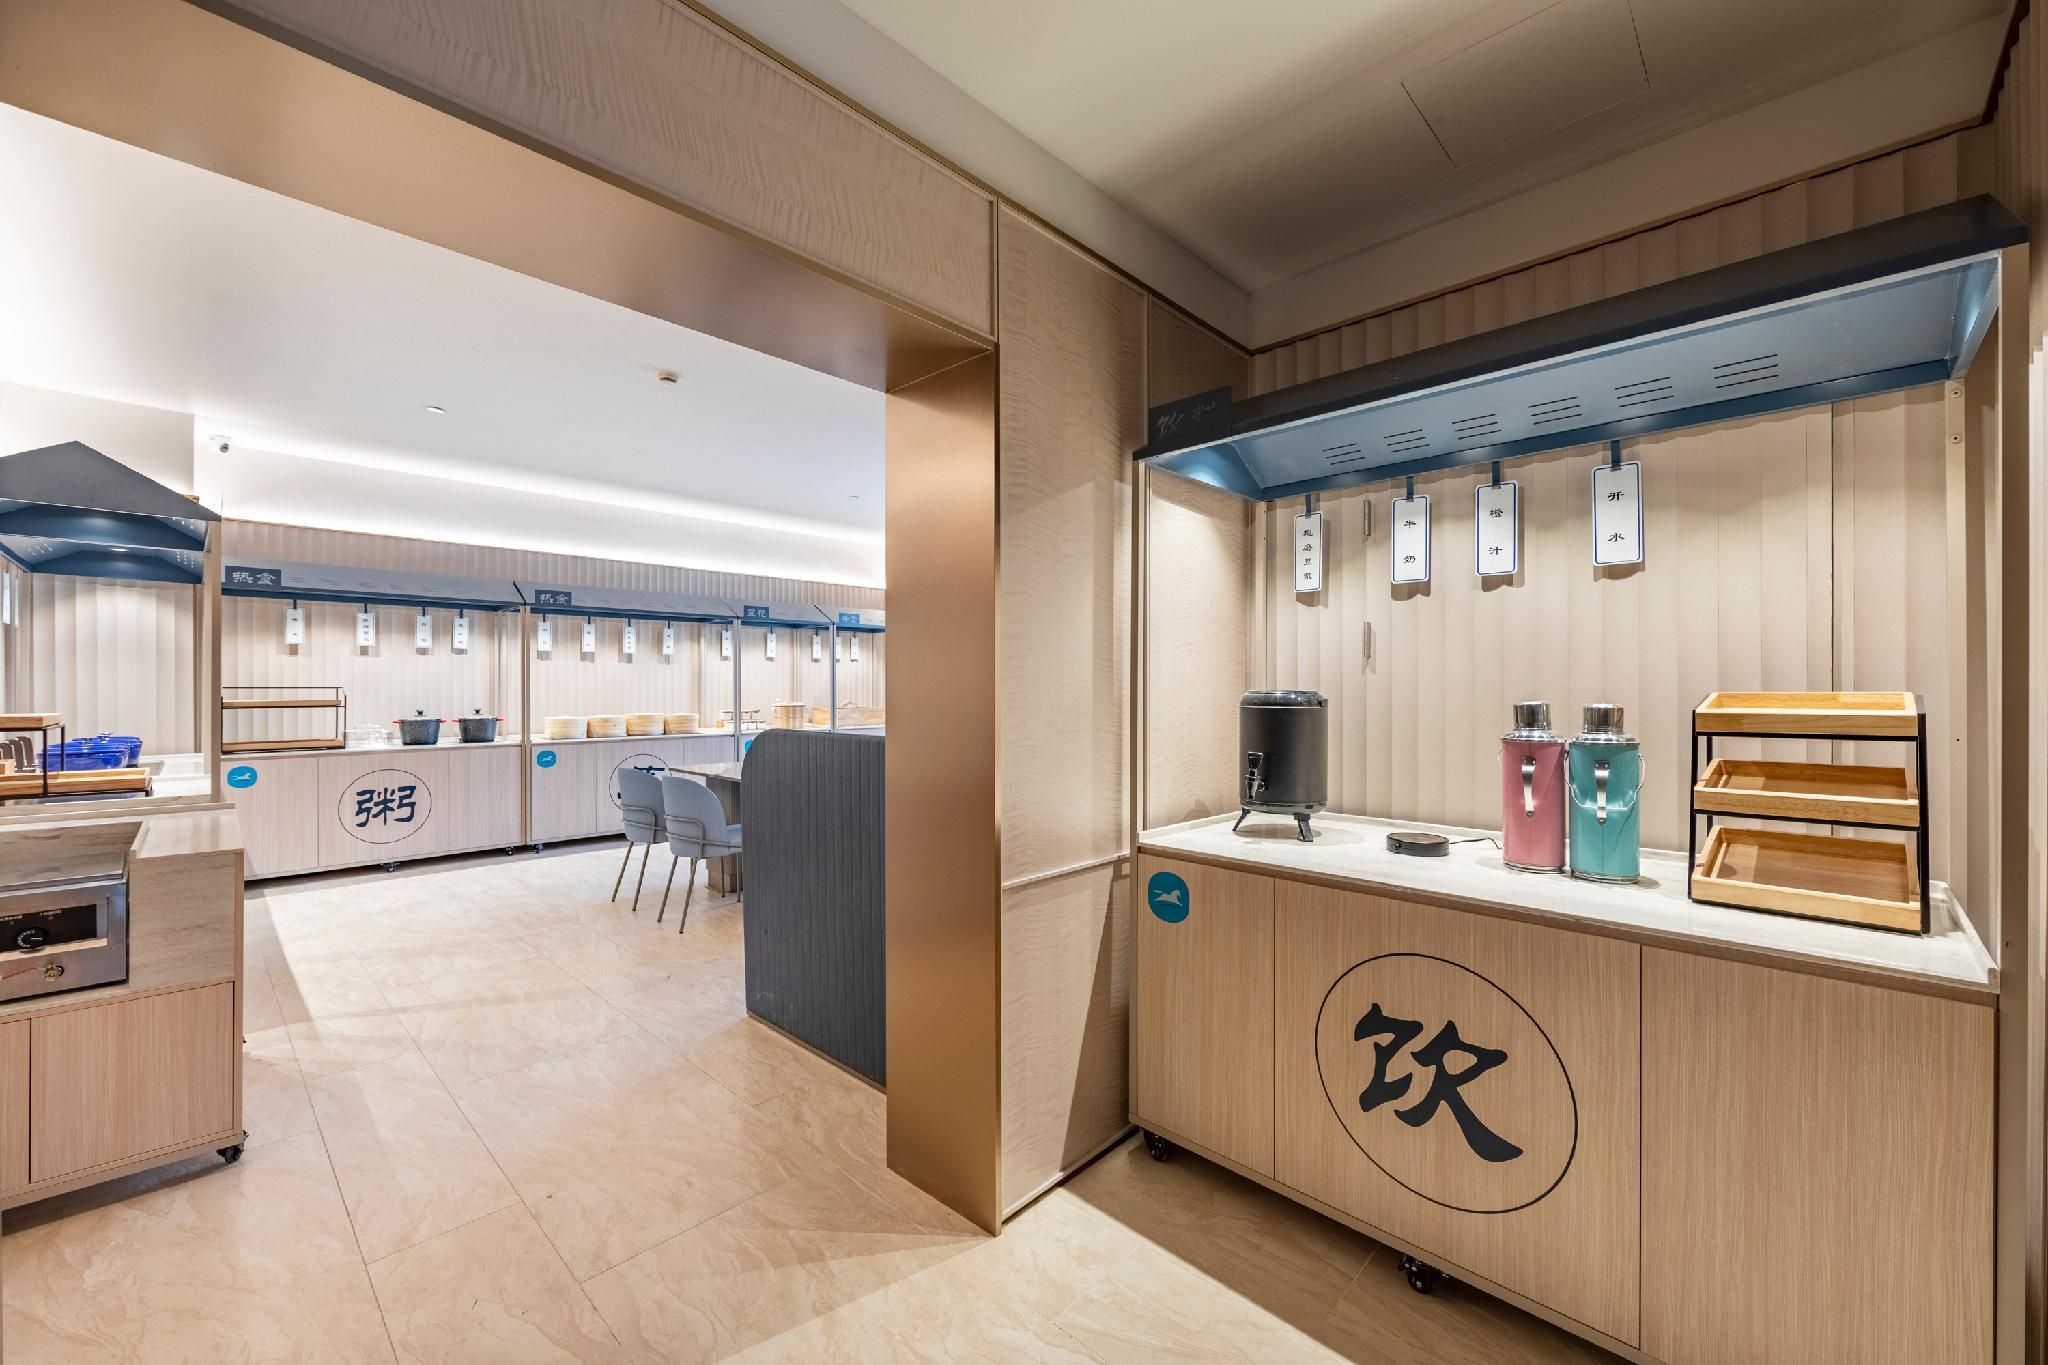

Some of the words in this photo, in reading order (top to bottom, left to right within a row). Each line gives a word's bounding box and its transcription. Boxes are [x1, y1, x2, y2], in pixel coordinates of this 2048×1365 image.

[1488, 508, 1504, 555] 橙汁
[1607, 491, 1625, 542] 开水
[1403, 519, 1417, 564] 牛奶
[355, 785, 417, 827] 粥
[1353, 1002, 1524, 1162] 饮
